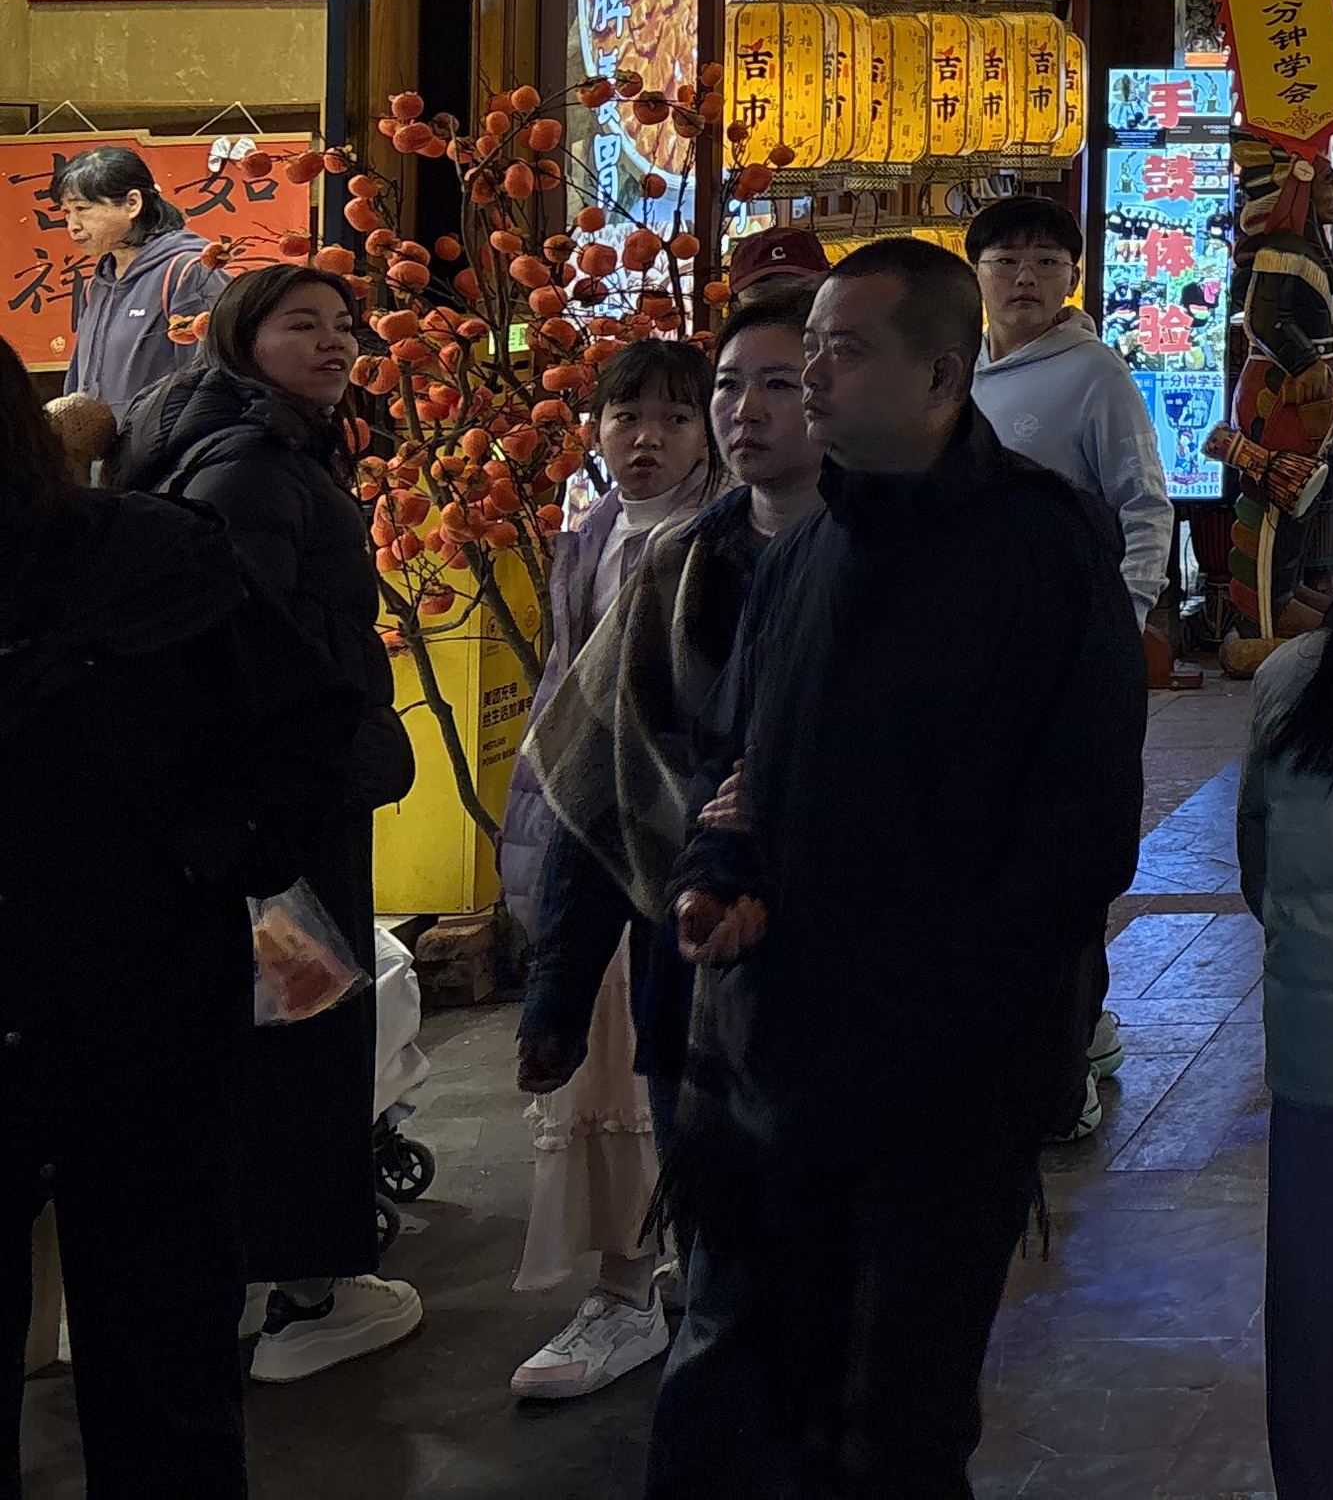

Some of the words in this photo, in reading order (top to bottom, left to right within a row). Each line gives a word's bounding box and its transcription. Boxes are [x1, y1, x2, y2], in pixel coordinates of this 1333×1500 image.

[737, 49, 774, 129] 吉市
[931, 52, 962, 124] 吉市
[1029, 49, 1055, 113] 吉市
[1138, 79, 1197, 355] 手鼓体验
